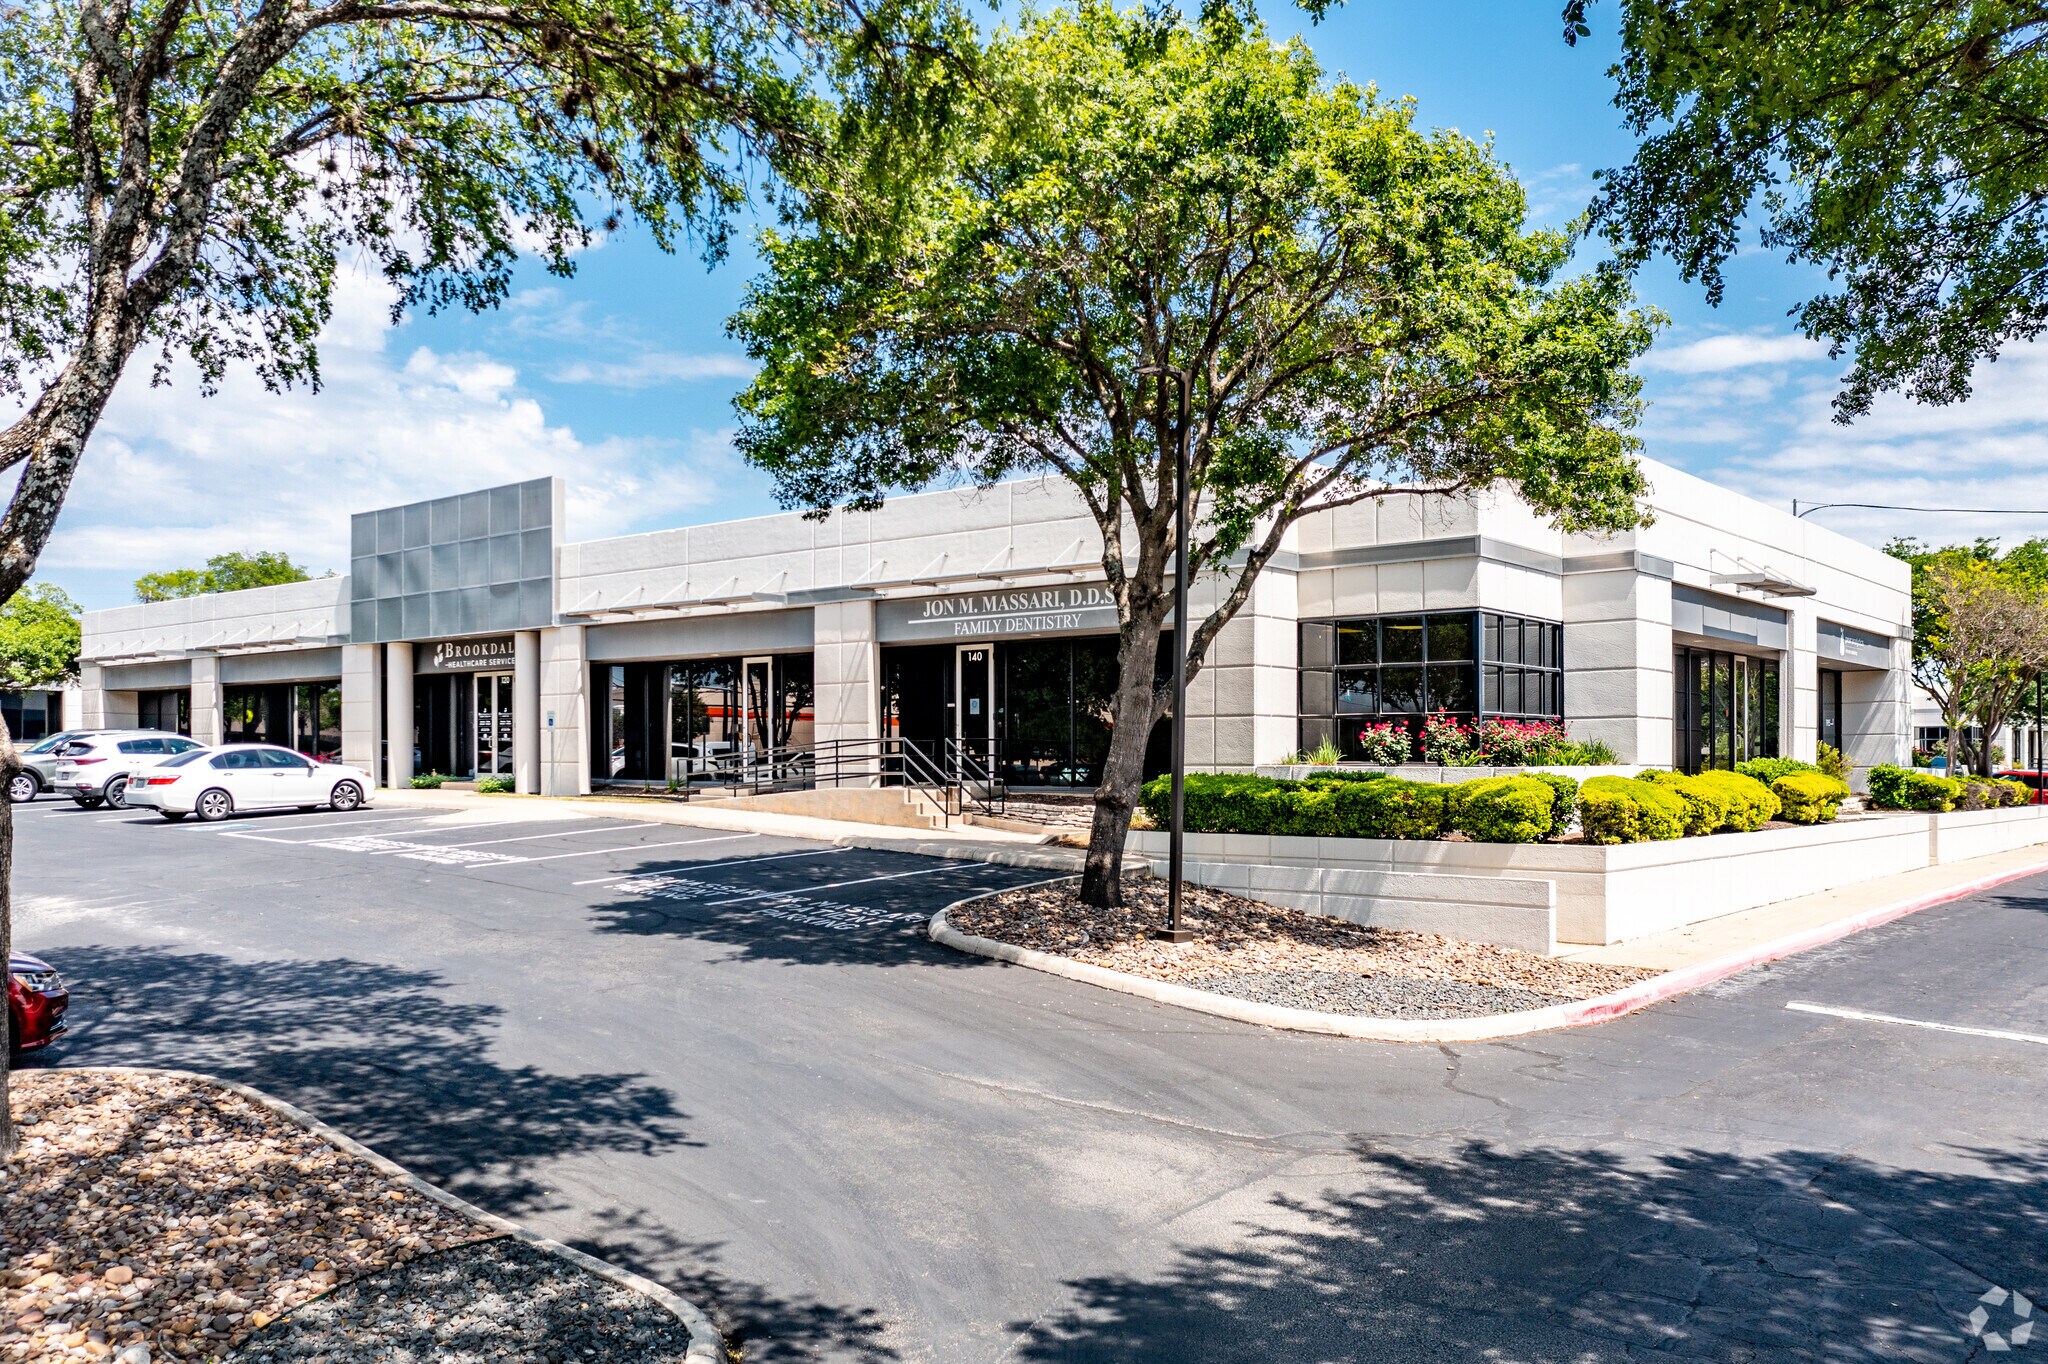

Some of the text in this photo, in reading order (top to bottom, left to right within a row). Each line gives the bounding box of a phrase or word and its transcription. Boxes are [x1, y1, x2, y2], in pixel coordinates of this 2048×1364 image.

[923, 599, 955, 617] JON
[959, 598, 978, 614] M.
[982, 591, 1065, 612] MASSARI,
[953, 613, 1082, 636] FAMILY DENTISTRY
[445, 642, 515, 658] BROOKDAL
[968, 651, 983, 662] 140
[488, 657, 516, 666] SERVICE
[751, 908, 860, 930] PARKING
[773, 903, 894, 926] PATIENT
